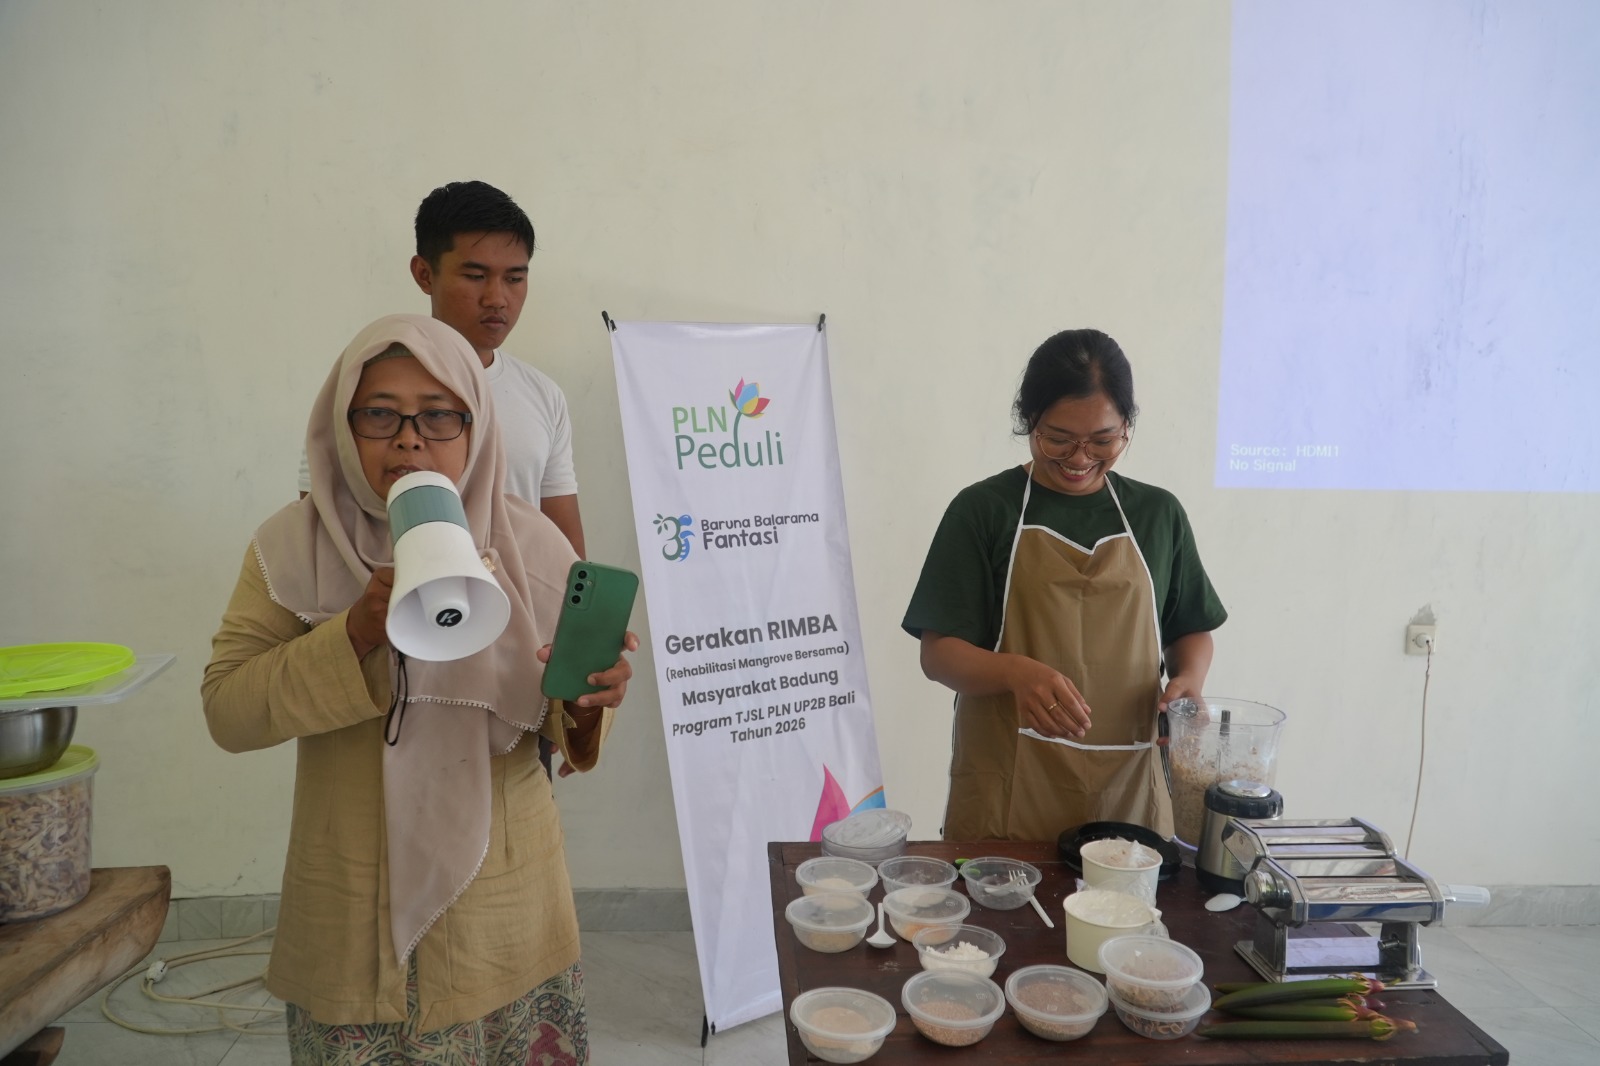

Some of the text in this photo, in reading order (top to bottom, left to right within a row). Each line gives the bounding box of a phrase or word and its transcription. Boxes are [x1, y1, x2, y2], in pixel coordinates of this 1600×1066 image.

[672, 406, 728, 433] PLN
[675, 430, 784, 470] Peduli
[1231, 444, 1340, 457] Source: HDMI1
[1230, 459, 1297, 473] No Signal
[701, 513, 819, 532] Baruna Balarama
[703, 526, 779, 550] Fantasi
[665, 614, 838, 654] Gerakan RIMBA
[666, 641, 849, 682] (Rehabilitasi Mangrove Bersama)
[682, 670, 839, 706] Masyarakat Badung
[672, 691, 856, 736] Program TJSL PLN UP2B Bali
[730, 717, 806, 743] Tahun 2026
